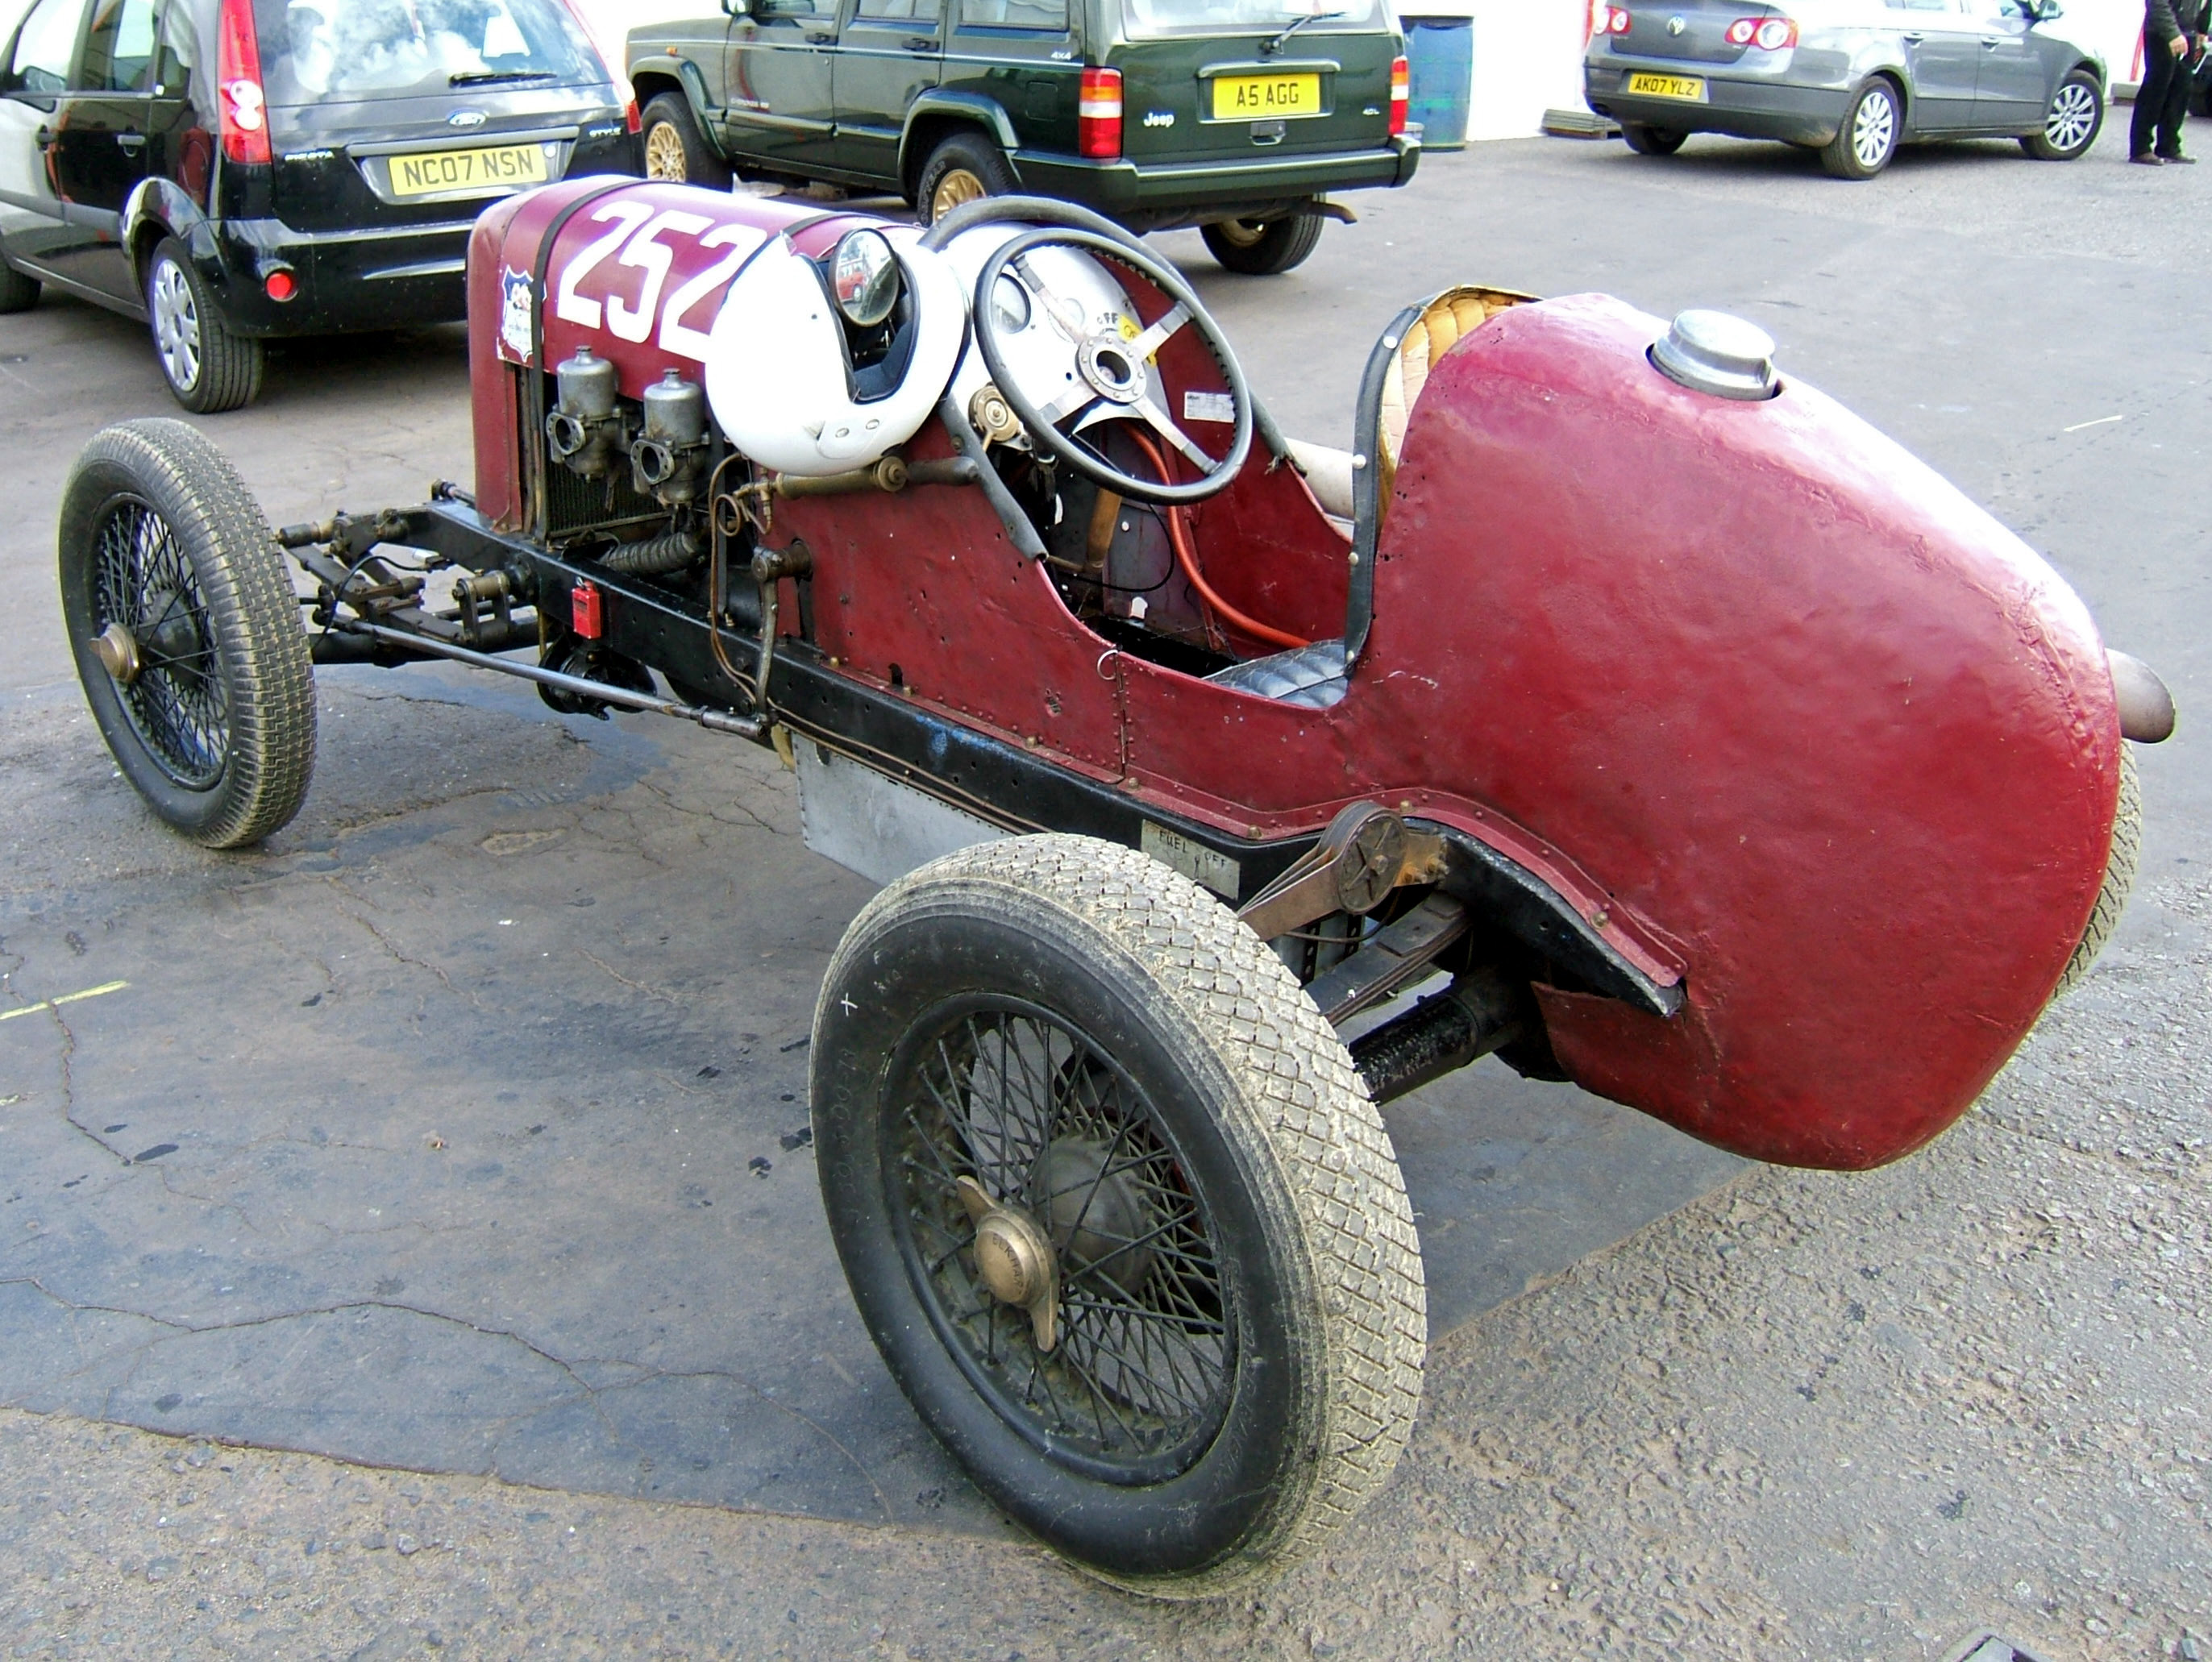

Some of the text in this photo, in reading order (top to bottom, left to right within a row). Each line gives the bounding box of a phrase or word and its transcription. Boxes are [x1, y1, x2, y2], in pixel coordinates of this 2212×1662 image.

[1237, 82, 1299, 106] A5 AGG
[1635, 78, 1696, 96] AK07 YLZ
[1143, 112, 1175, 128] Jeep
[403, 148, 534, 187] NC07 NSN
[556, 200, 768, 365] 252
[1159, 830, 1187, 854] FUEL
